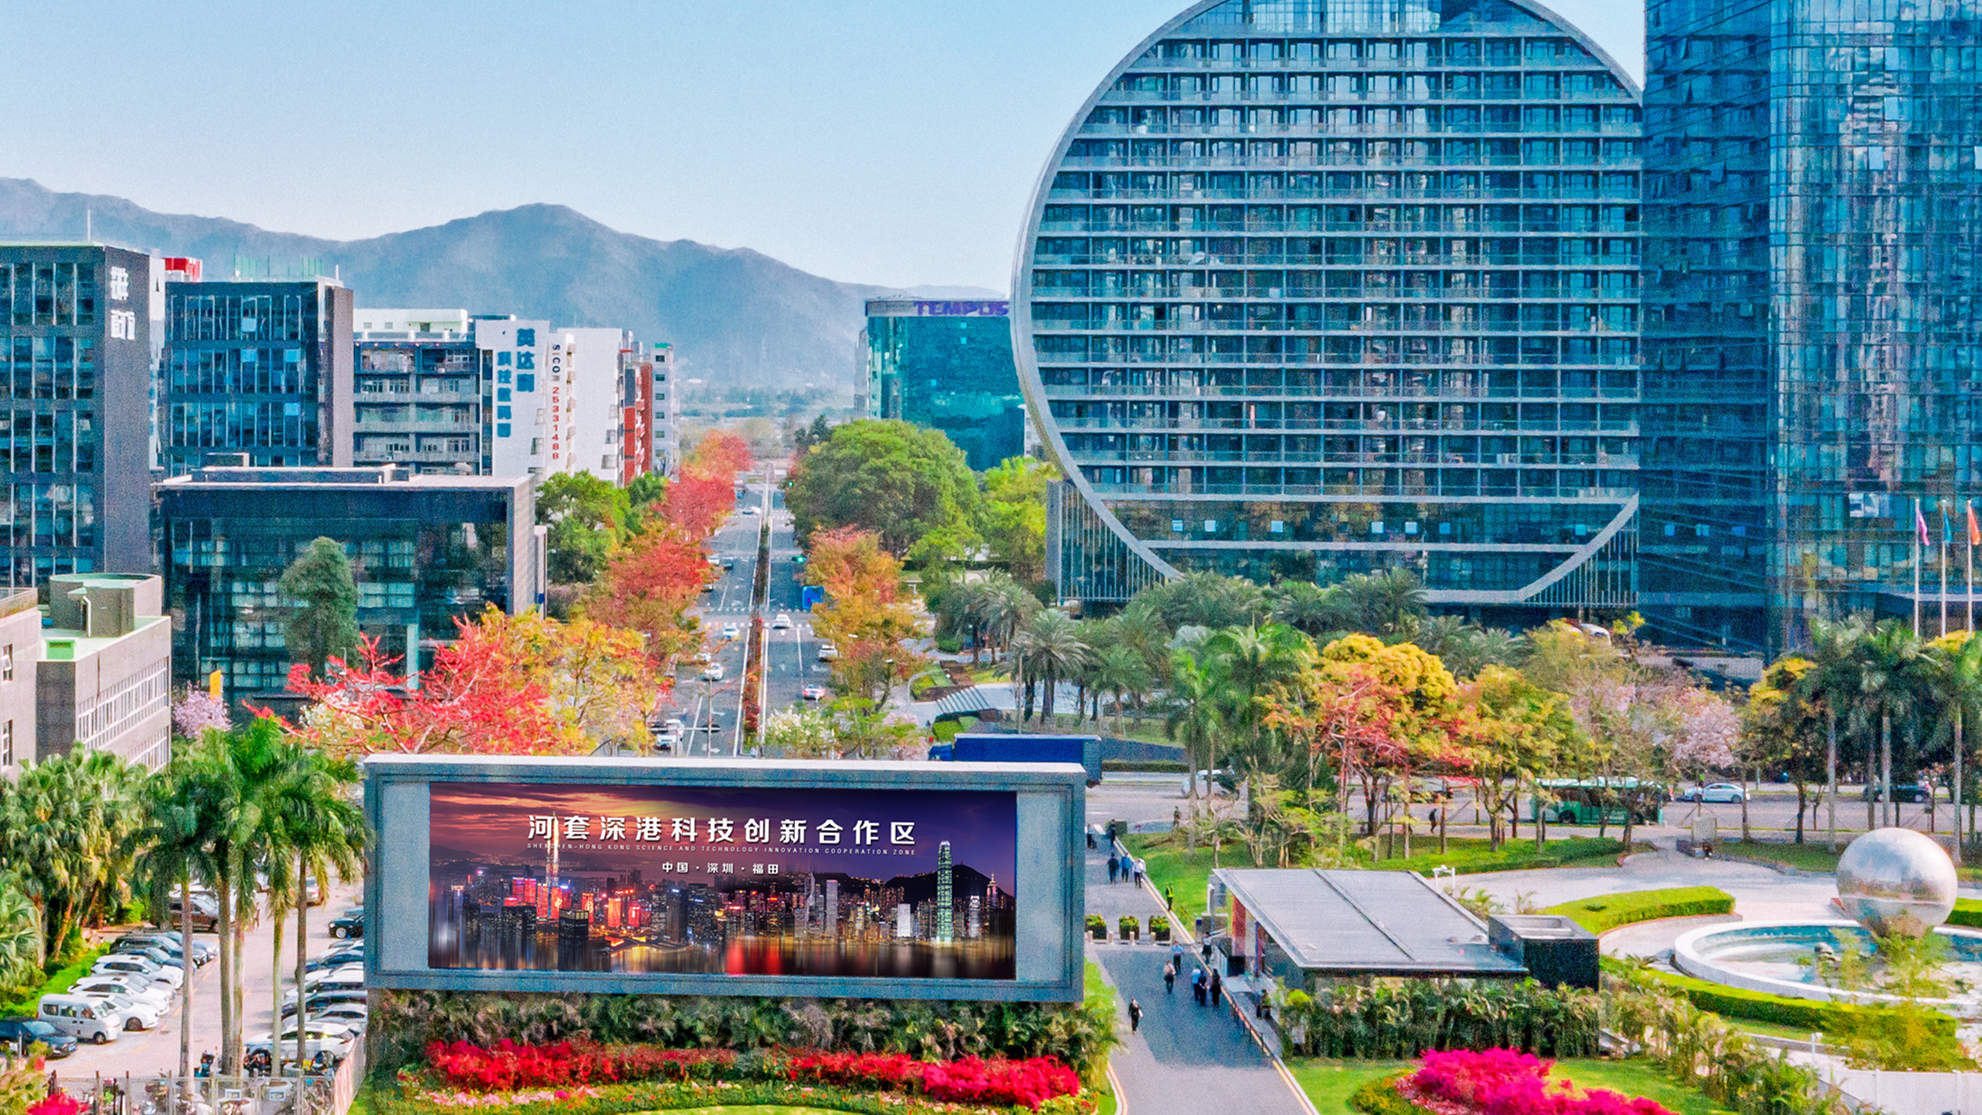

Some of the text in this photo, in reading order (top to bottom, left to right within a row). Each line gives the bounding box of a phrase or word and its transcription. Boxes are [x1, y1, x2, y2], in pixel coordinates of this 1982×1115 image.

[914, 301, 1009, 315] TEMPUS
[528, 815, 915, 847] 河套深港科技创新合作区
